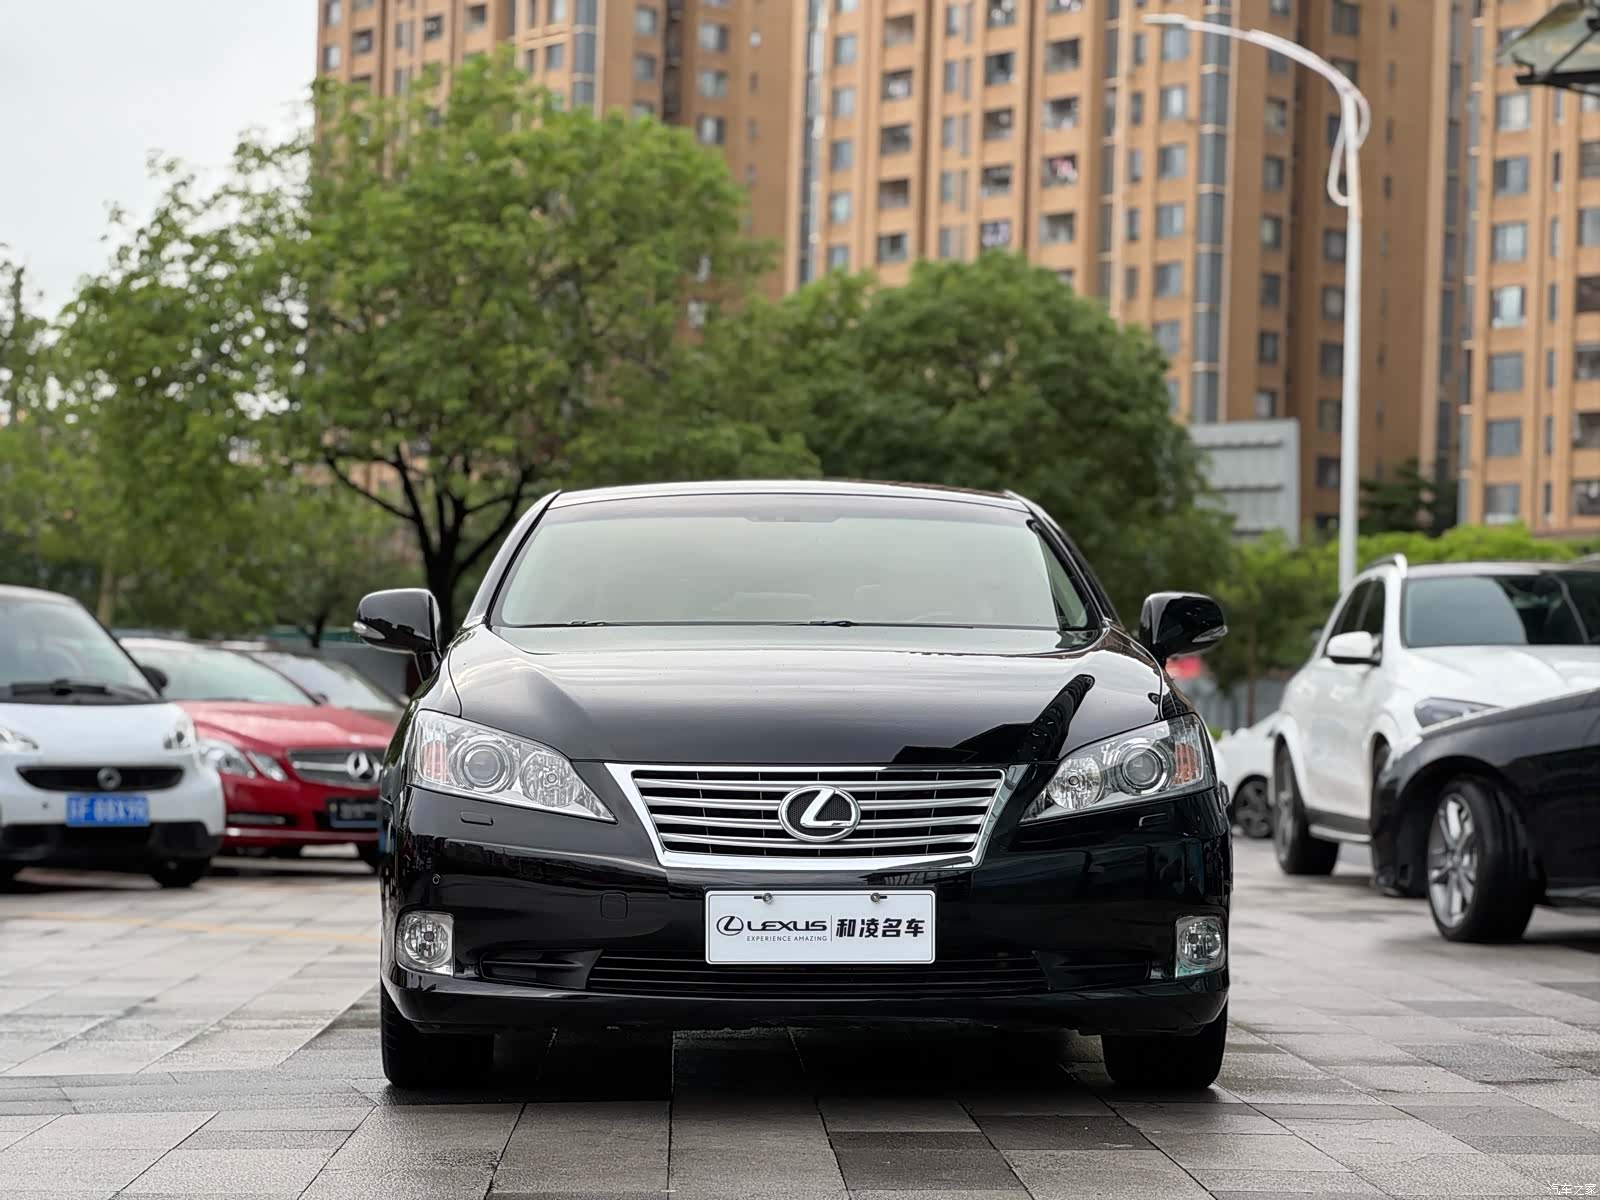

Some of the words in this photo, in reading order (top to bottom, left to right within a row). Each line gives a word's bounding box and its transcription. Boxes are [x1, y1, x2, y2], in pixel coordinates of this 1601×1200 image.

[746, 920, 828, 932] LEXUS
[835, 917, 926, 939] 和凌名车
